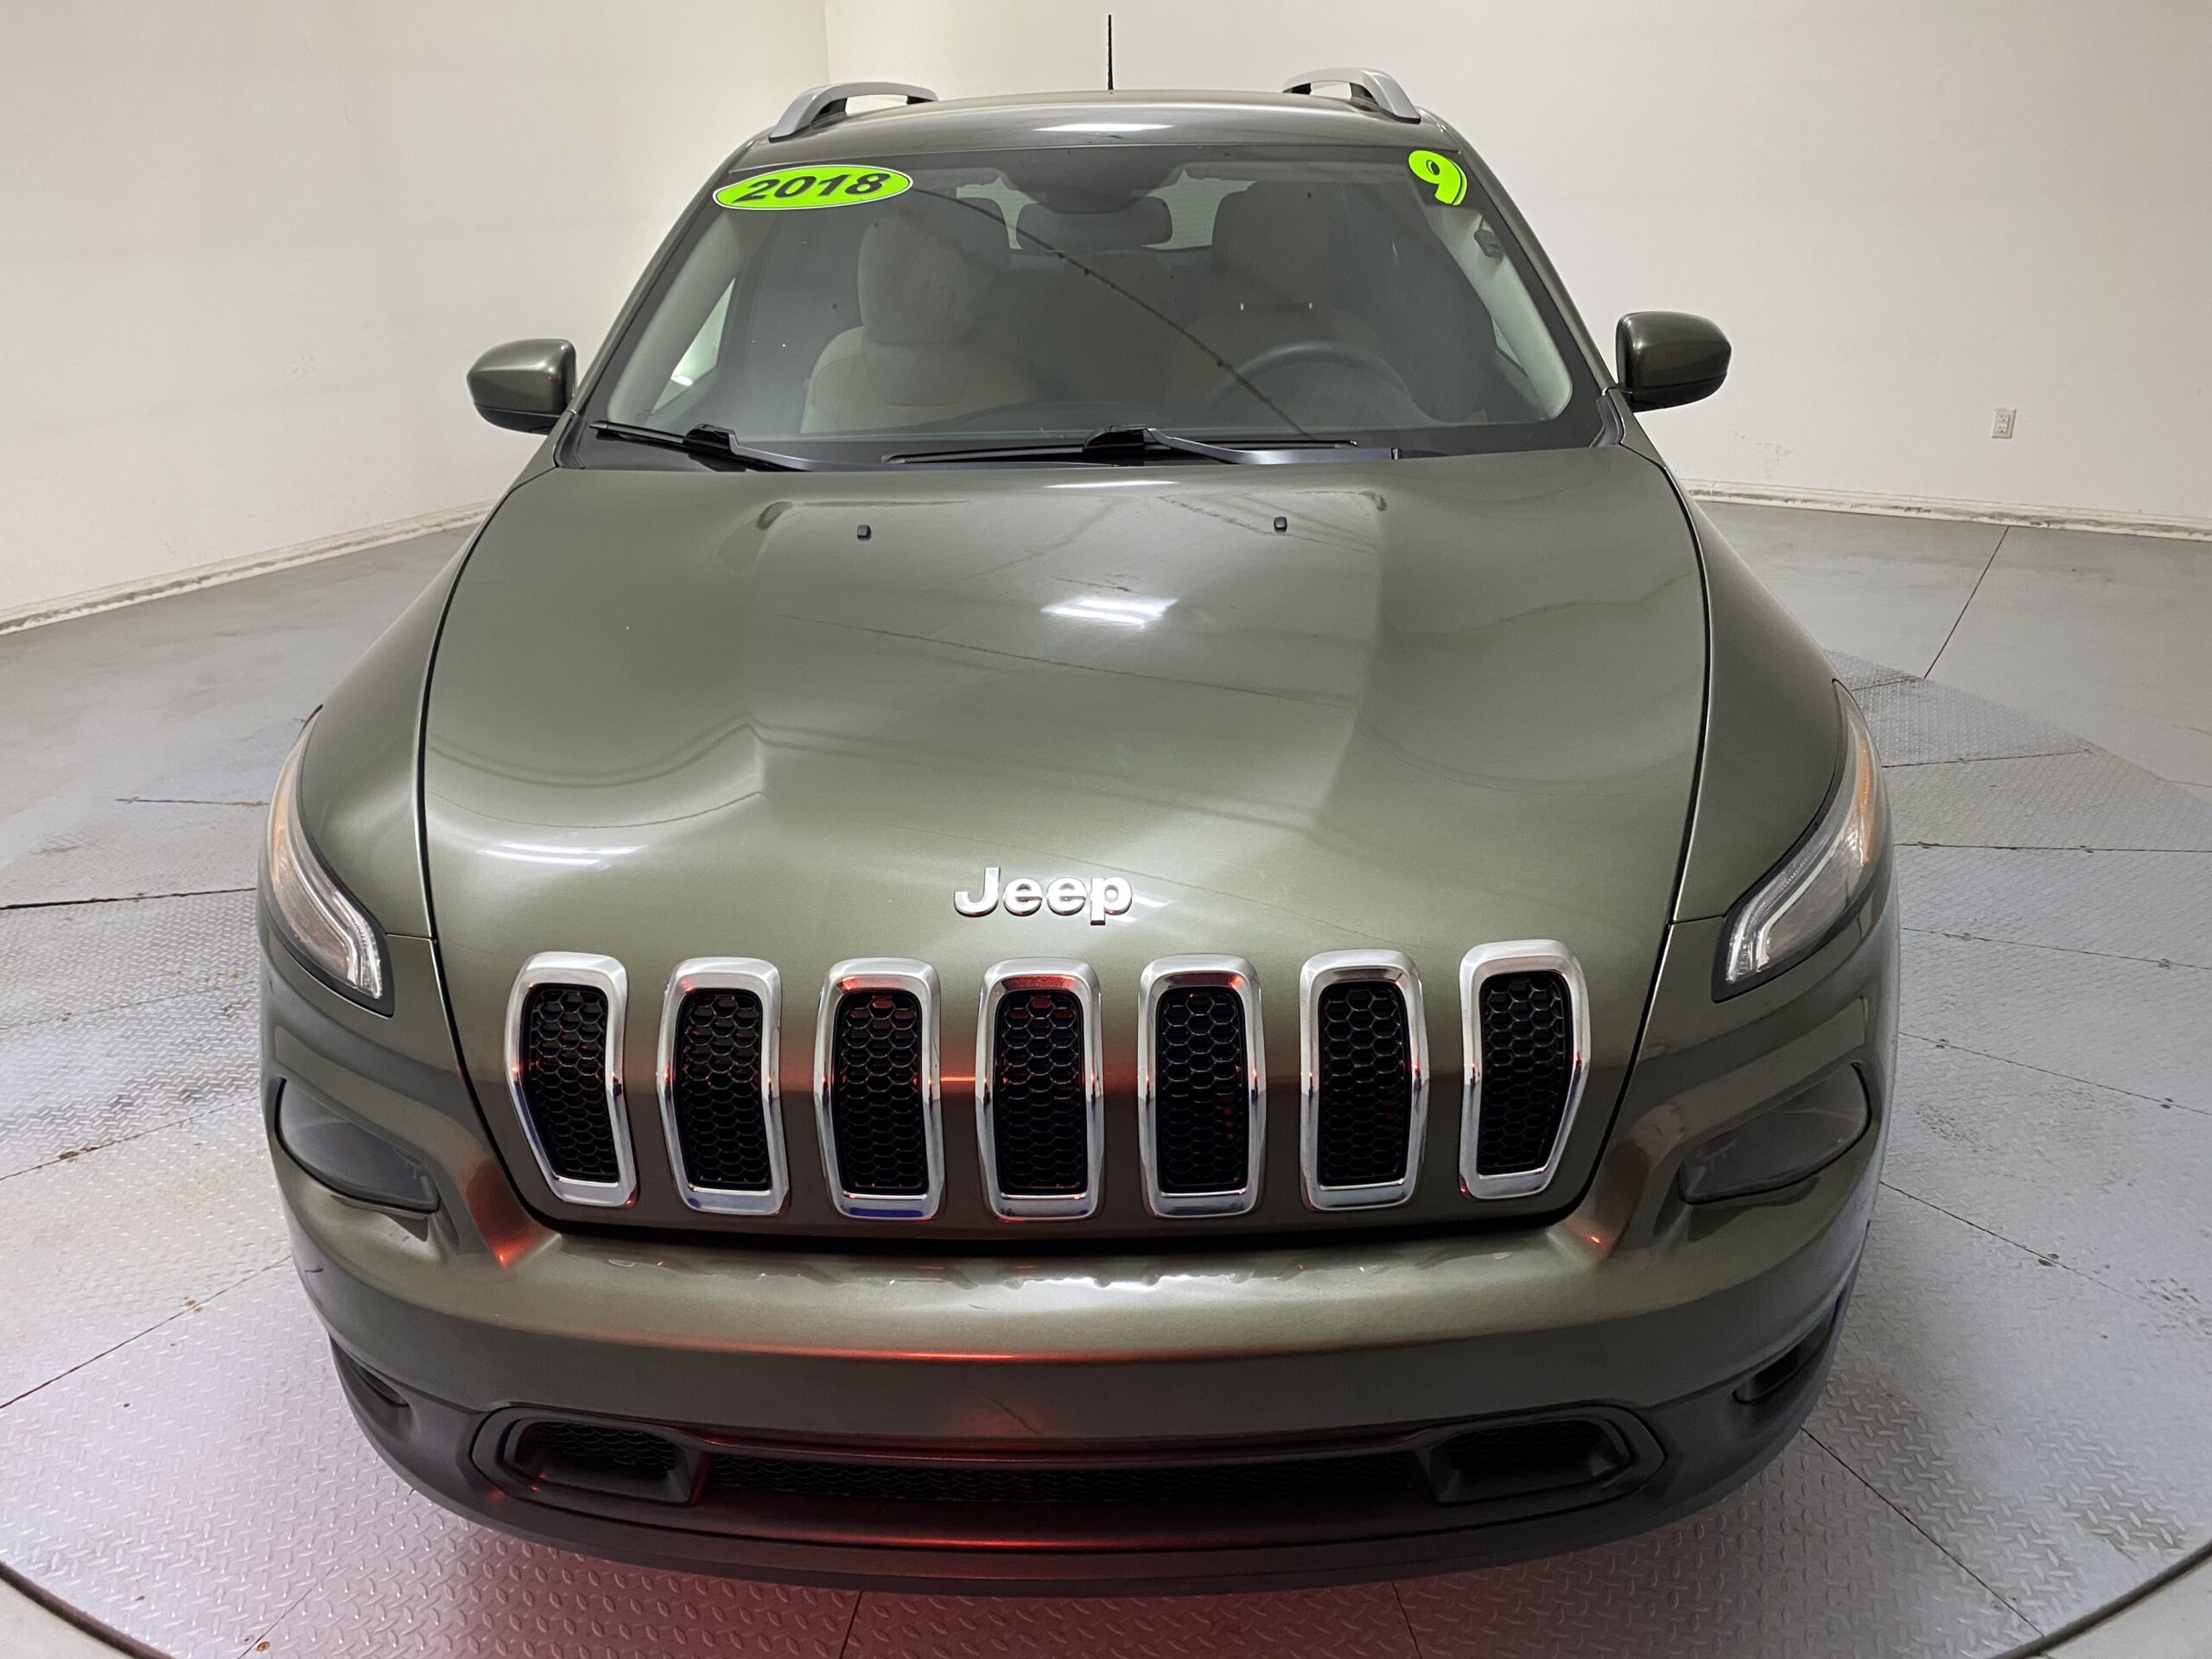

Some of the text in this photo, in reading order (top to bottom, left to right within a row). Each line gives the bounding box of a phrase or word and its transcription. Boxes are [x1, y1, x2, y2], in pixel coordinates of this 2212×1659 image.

[731, 173, 891, 204] 2018
[1408, 149, 1467, 206] 9
[954, 867, 1133, 926] Jeep
